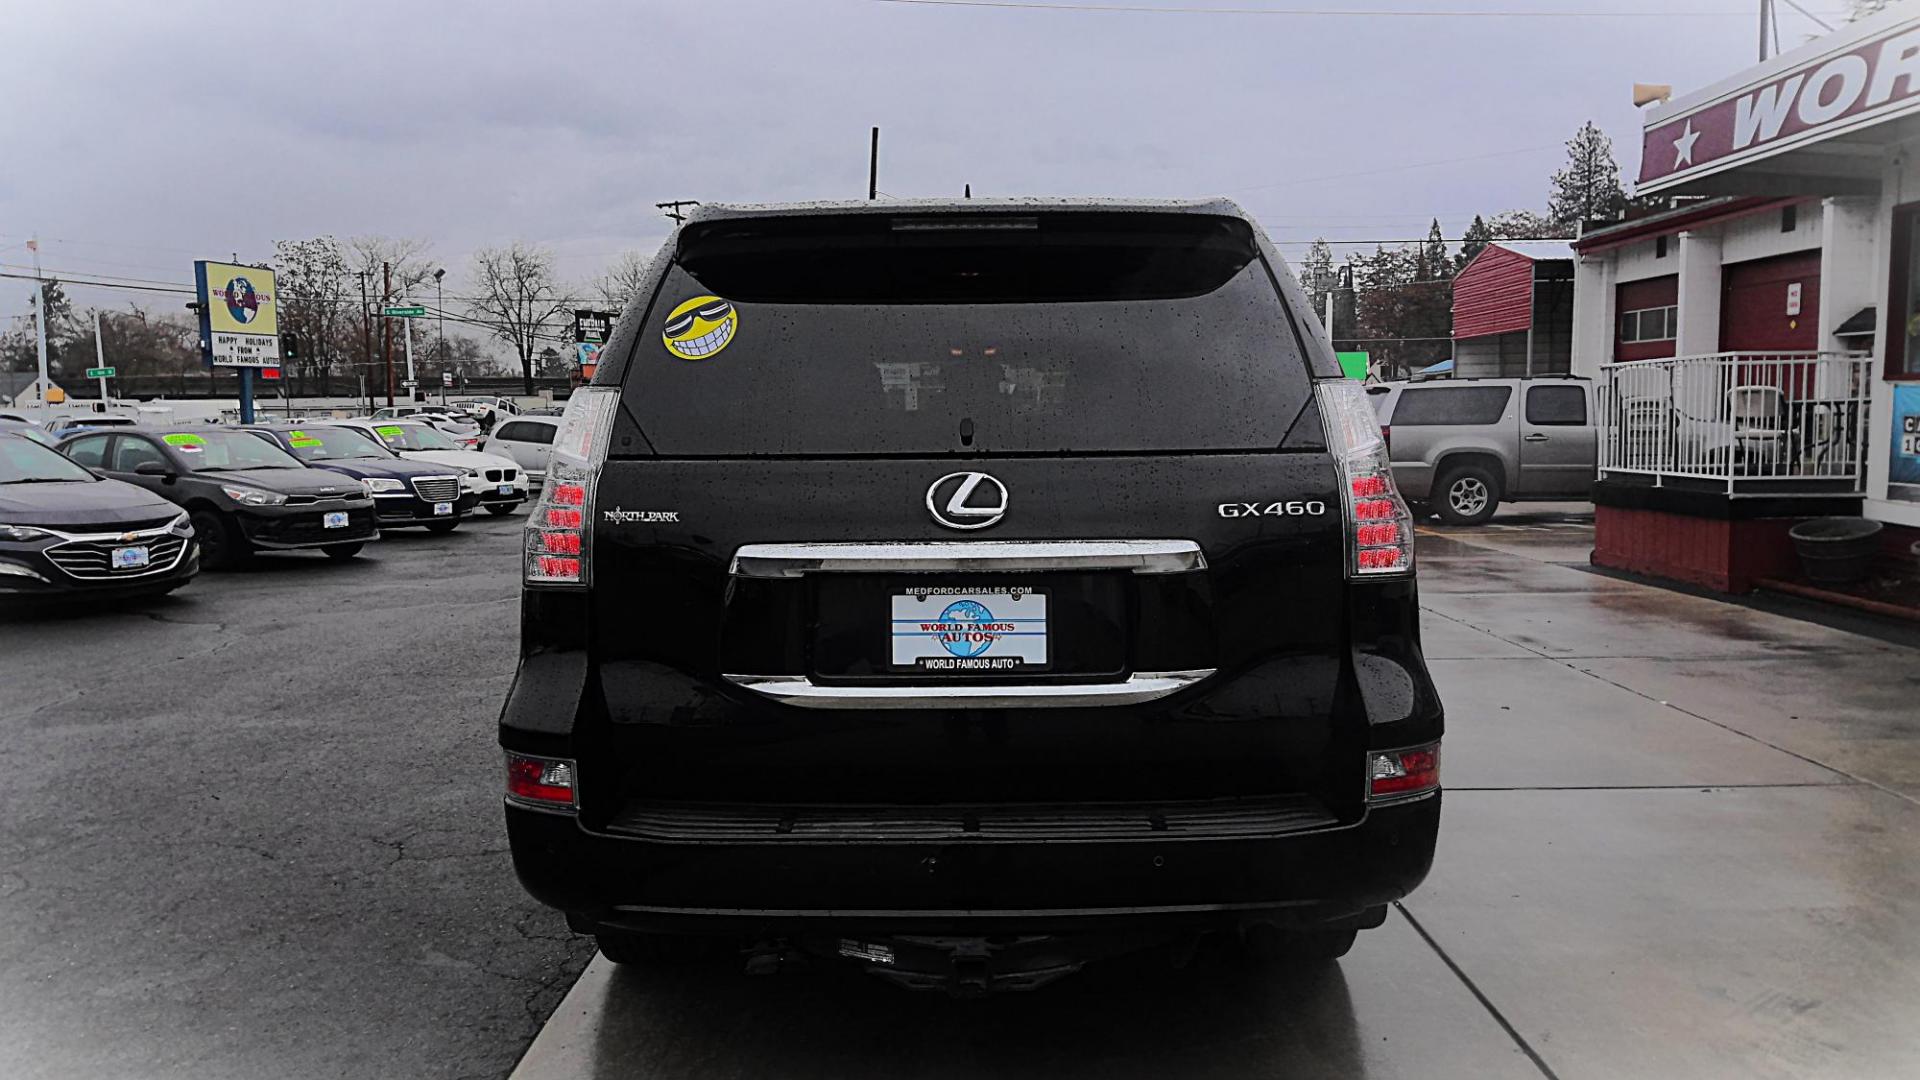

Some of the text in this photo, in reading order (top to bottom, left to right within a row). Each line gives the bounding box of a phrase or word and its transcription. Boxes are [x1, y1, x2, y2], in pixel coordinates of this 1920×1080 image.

[1734, 28, 1920, 150] WOR
[218, 336, 273, 346] HAPPY HOLIDAYS
[214, 355, 280, 365] WORLD FAMOUS AUTOS
[604, 507, 680, 523] NORTH PARK
[906, 586, 1032, 595] MEDFORDCARSALES.COM
[920, 623, 1015, 632] WORLD FAMOUS
[943, 632, 994, 642] AUTOS
[925, 658, 1014, 669] WORLD FAMOUS AUTO
